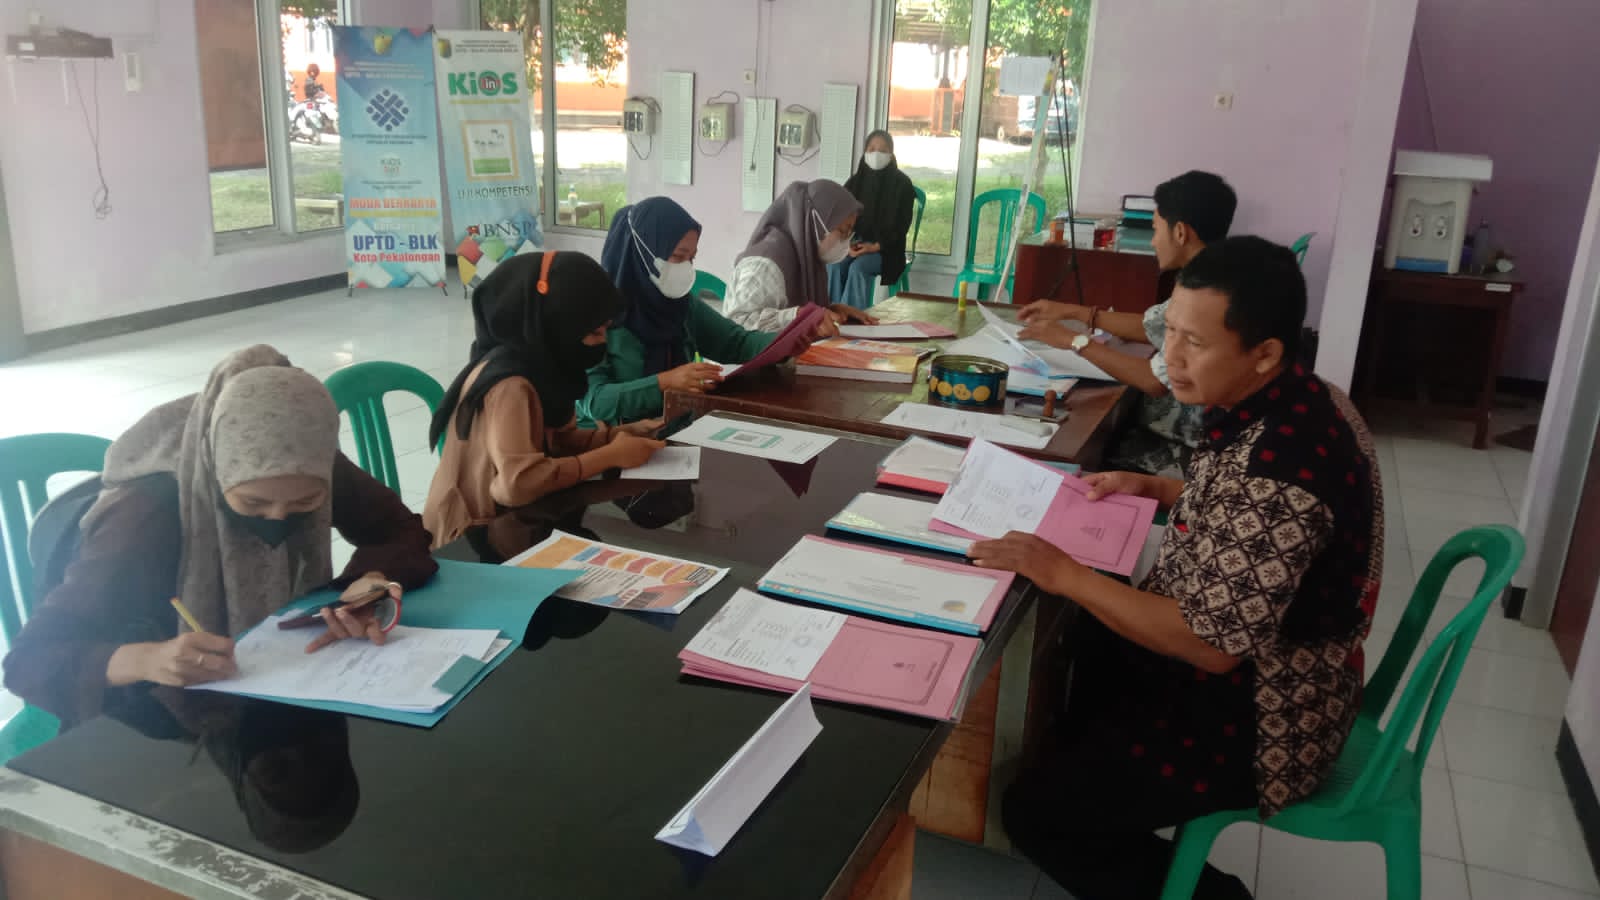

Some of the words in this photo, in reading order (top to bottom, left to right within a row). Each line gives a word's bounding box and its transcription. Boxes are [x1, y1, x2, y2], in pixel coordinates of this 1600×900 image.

[353, 235, 396, 251] UPTD
[408, 234, 439, 250] BLK
[353, 252, 377, 263] Kota
[379, 251, 441, 263] Pekalongan
